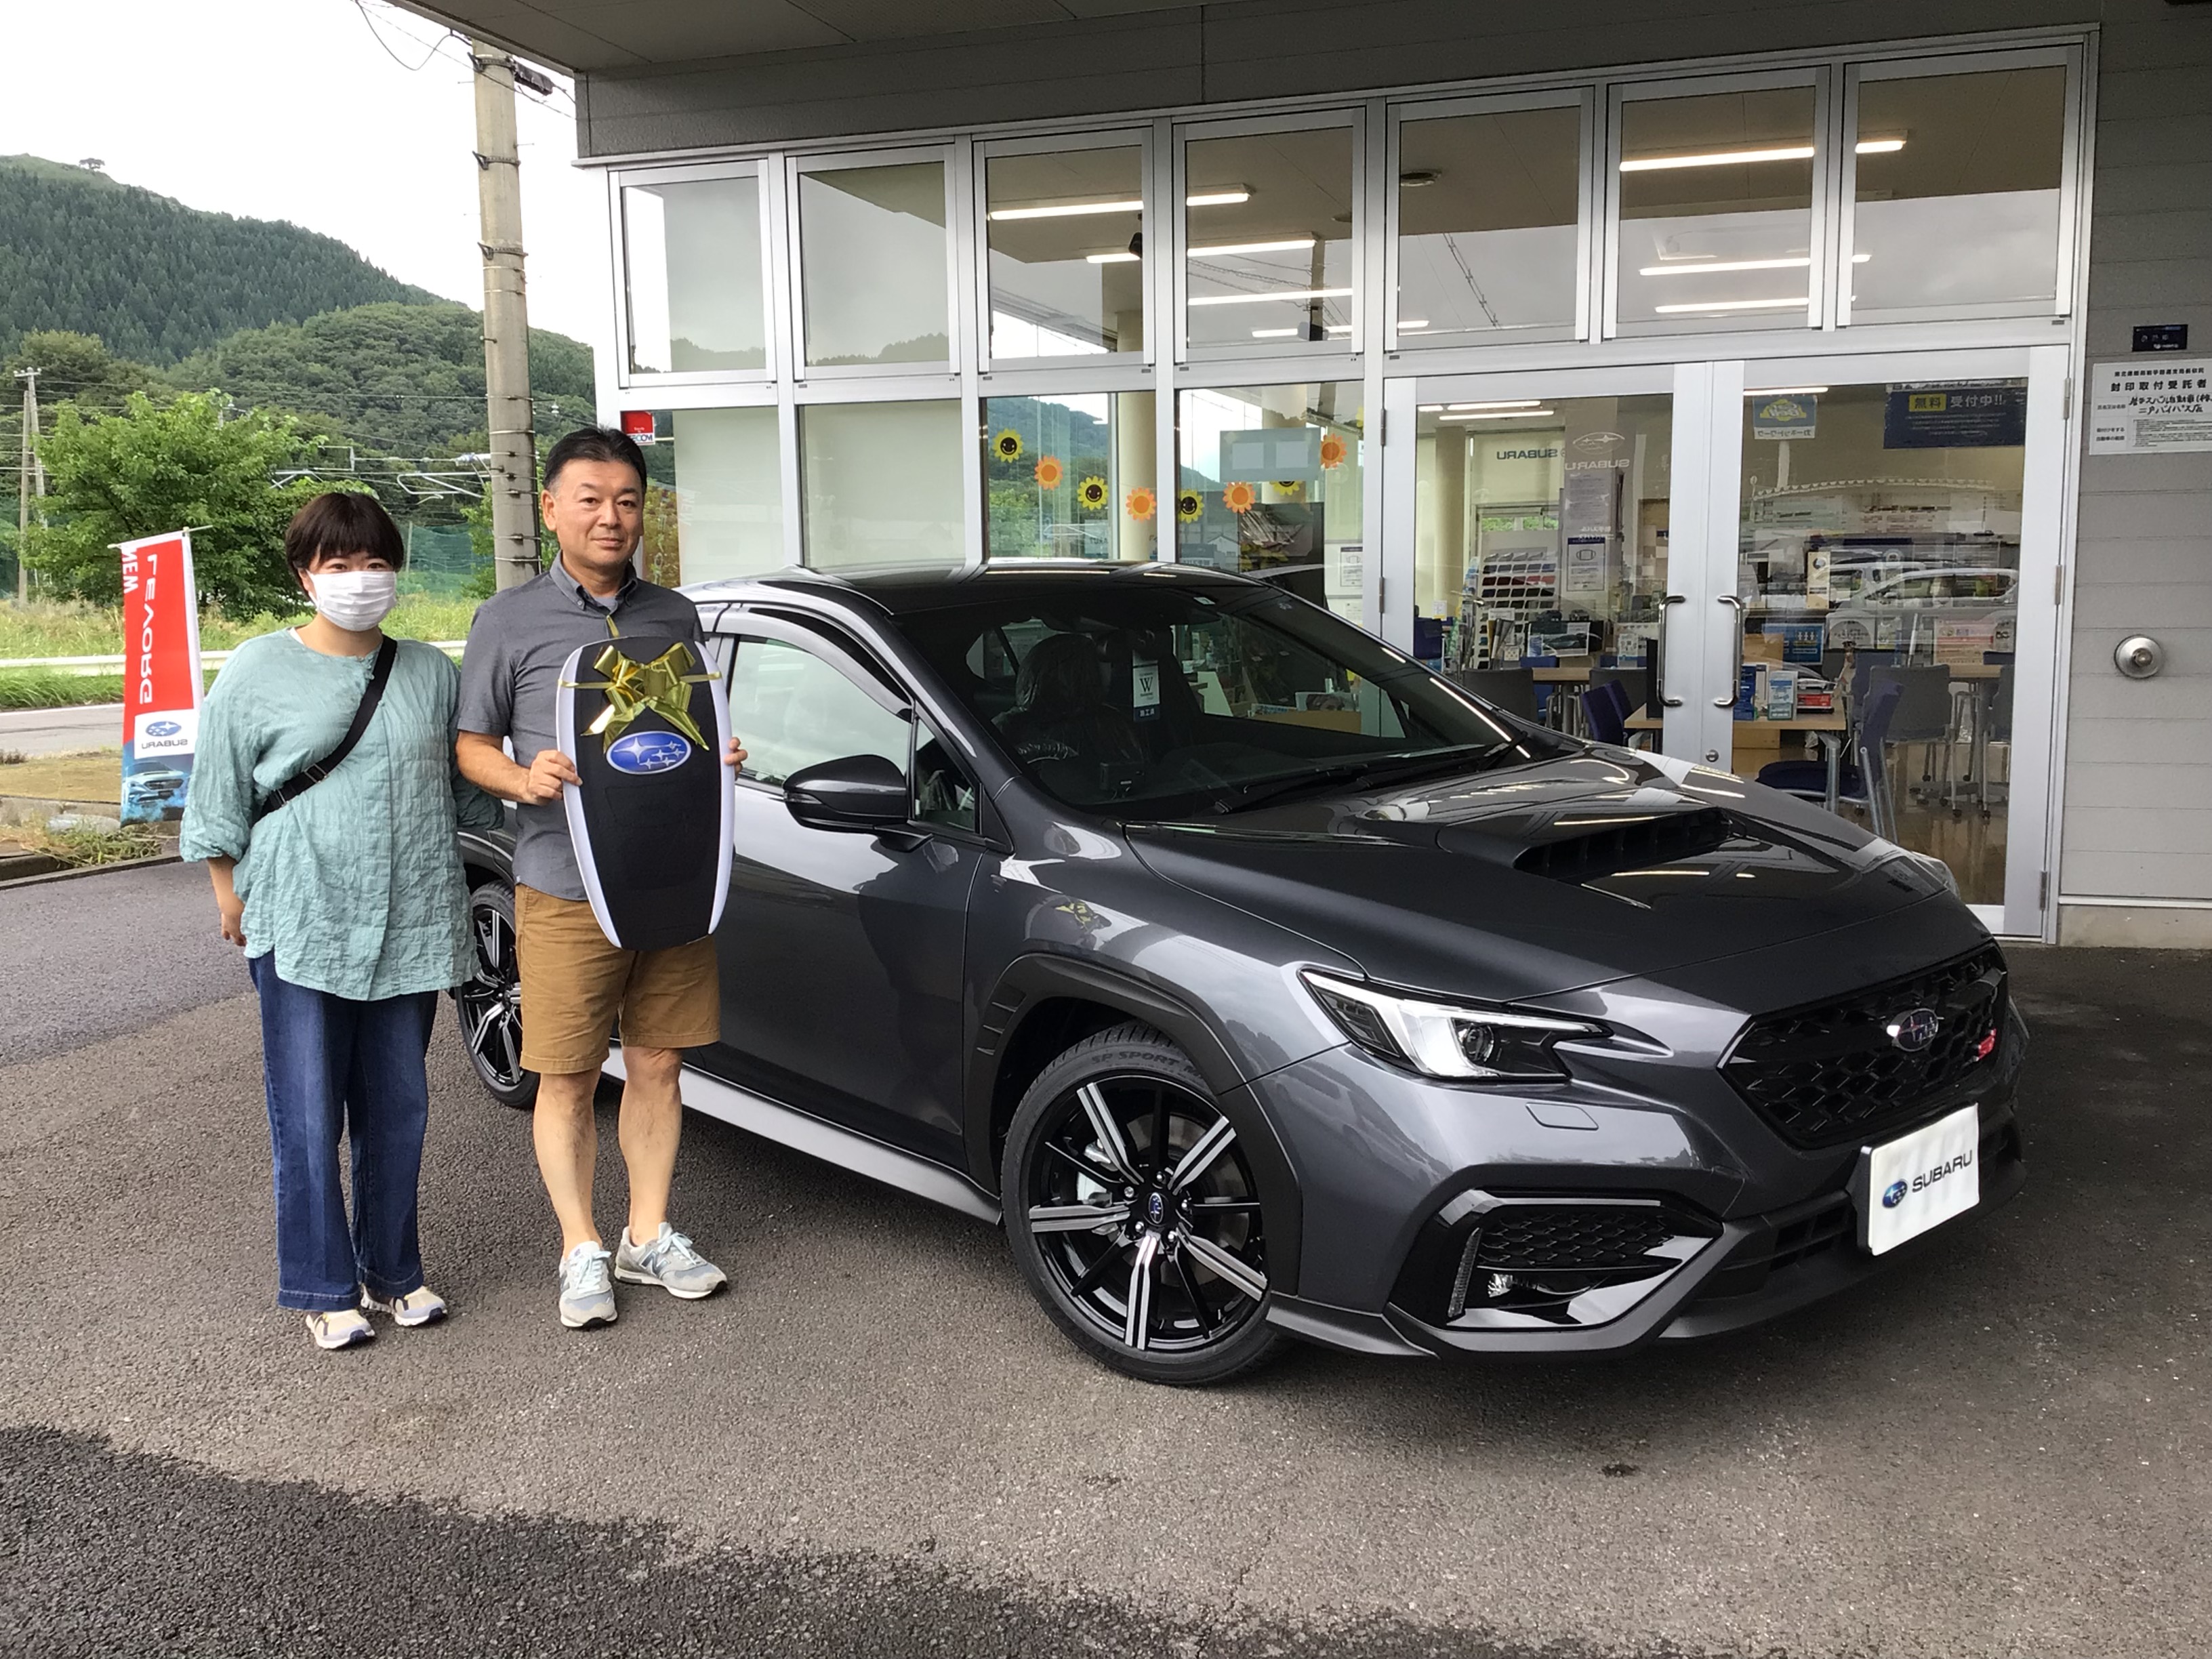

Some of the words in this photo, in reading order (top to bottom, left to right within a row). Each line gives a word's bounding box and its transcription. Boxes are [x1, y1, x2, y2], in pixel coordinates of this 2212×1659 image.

[2110, 379, 2207, 392] 封印取付受託者
[1914, 396, 1942, 409] 無料
[1950, 394, 2003, 408] 受付中!!
[1092, 1053, 1113, 1064] SP
[1119, 1051, 1180, 1065] SPORT
[1912, 1149, 1972, 1193] SUBARU
